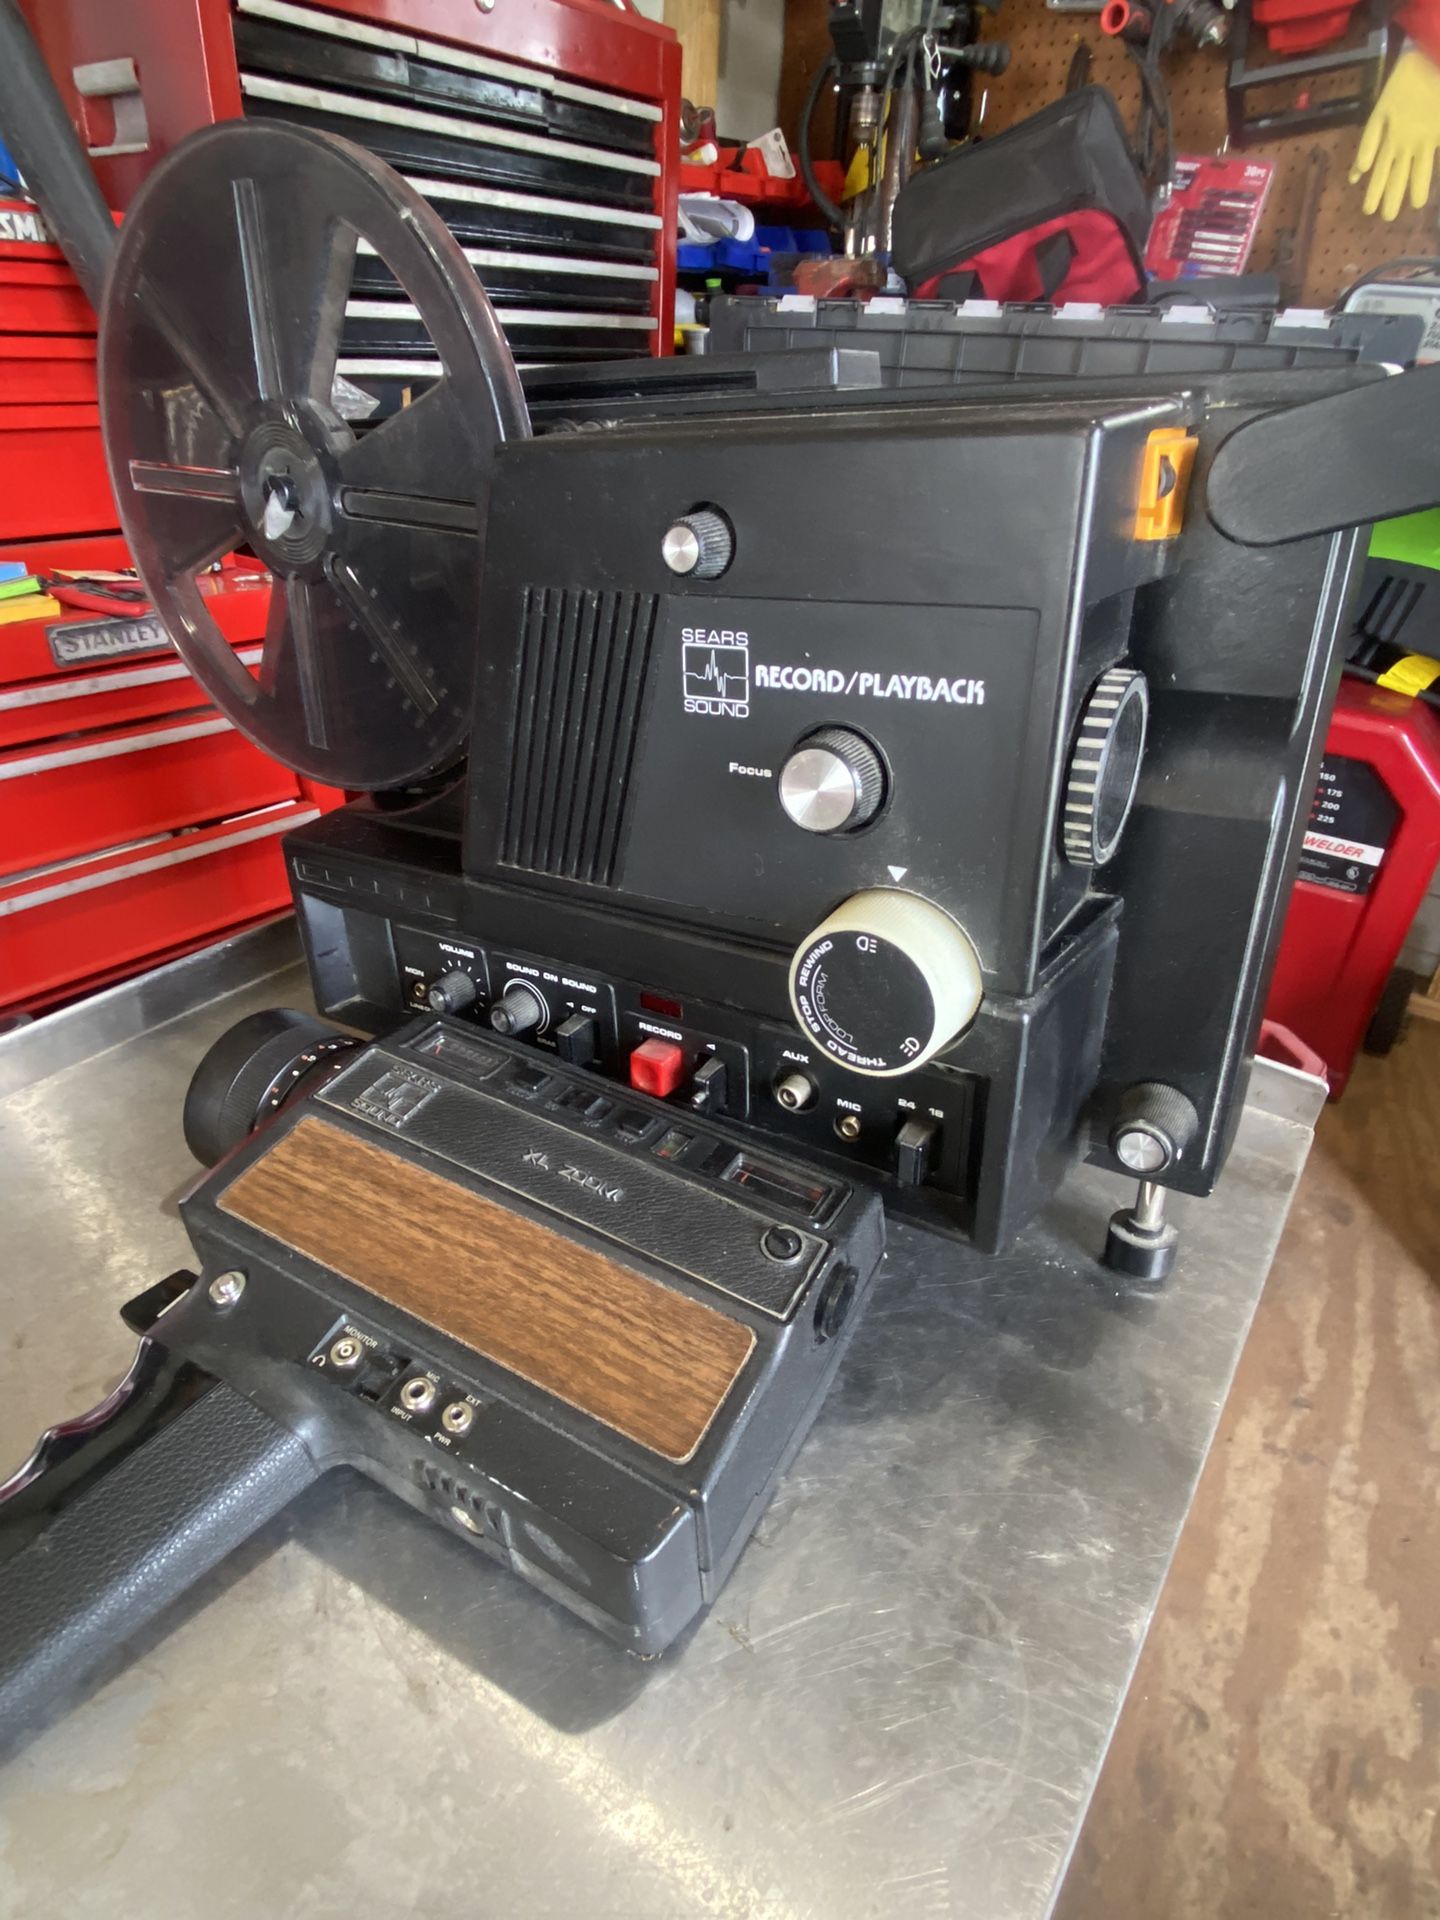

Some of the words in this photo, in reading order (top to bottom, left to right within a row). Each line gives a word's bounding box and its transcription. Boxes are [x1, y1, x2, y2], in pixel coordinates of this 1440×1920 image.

[63, 620, 161, 654] STANLEY
[681, 628, 749, 646] SEARS
[755, 664, 985, 705] RECORD/PLAYBACK
[684, 699, 749, 718] SOUND
[728, 762, 772, 778] Focus
[1320, 771, 1336, 782] 150
[1327, 788, 1342, 798] 175
[1321, 800, 1340, 811] 200
[1316, 813, 1335, 824] 225
[1304, 836, 1364, 858] WELDER
[439, 942, 475, 959] VOLUME
[799, 940, 834, 987] REWIND
[506, 962, 540, 977] SOUND
[543, 972, 559, 983] ON
[561, 977, 598, 994] SOUND
[815, 972, 829, 1013] FORM
[799, 995, 821, 1033] STOP
[638, 1021, 683, 1041] RECORD
[823, 1012, 854, 1043] LOOP
[782, 1049, 810, 1065] AUX
[826, 1039, 887, 1067] THREAD
[350, 1097, 402, 1129] SOUND
[836, 1097, 862, 1113] MIC
[897, 1097, 917, 1110] 24
[928, 1107, 944, 1119] 18
[522, 1148, 549, 1171] XL
[557, 1163, 626, 1202] ZOOM
[343, 1324, 378, 1349] MONITOR
[425, 1371, 441, 1384] MIC
[465, 1394, 482, 1408] EXT
[433, 1431, 452, 1447] PWR
